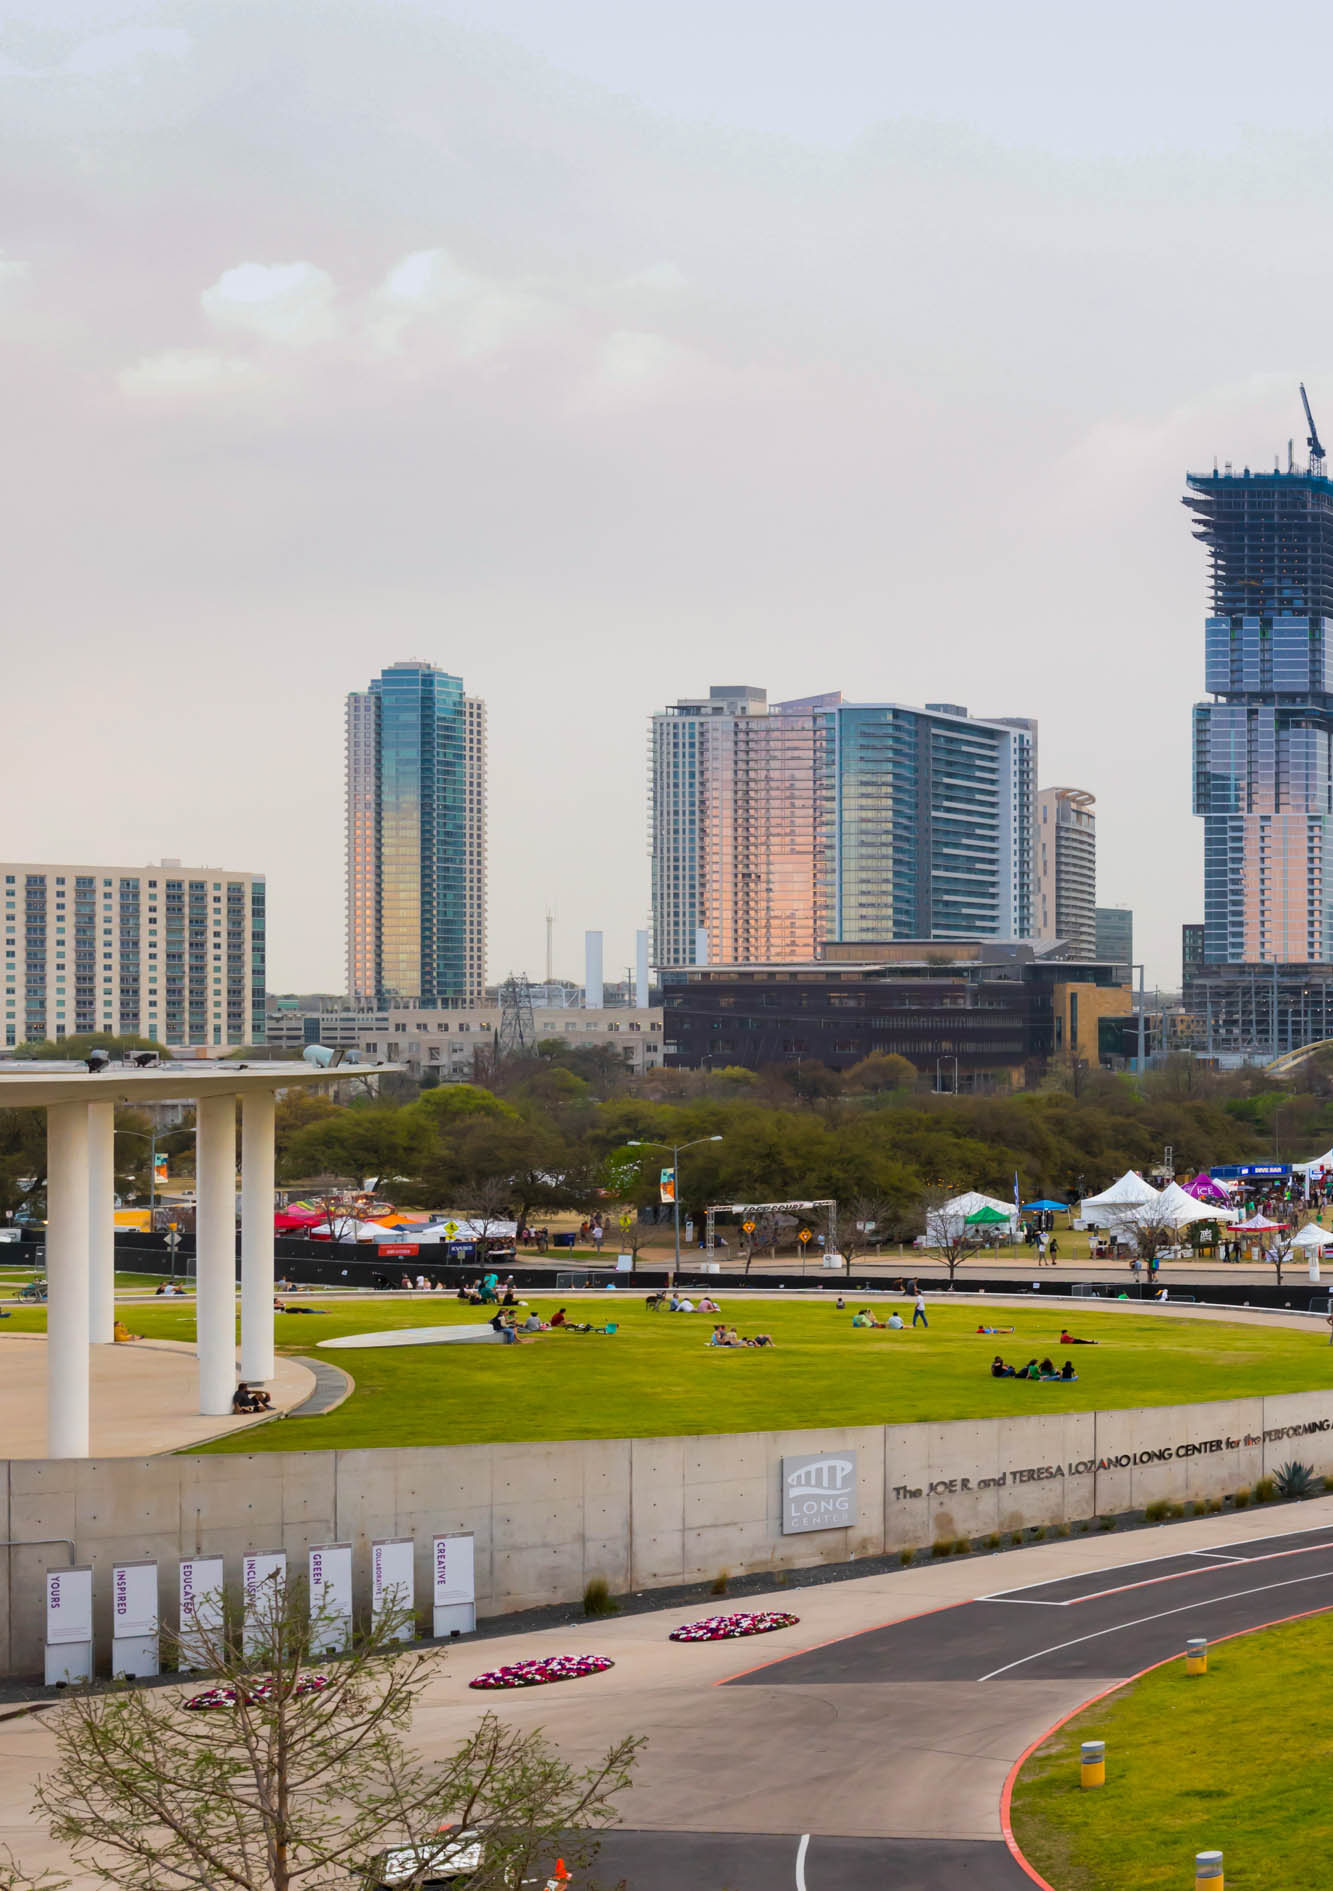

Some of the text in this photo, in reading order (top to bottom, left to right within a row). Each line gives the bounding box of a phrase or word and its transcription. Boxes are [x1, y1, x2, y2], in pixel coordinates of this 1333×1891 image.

[1197, 1187, 1214, 1195] ICE
[893, 1486, 923, 1500] The
[926, 1478, 957, 1496] JOE
[977, 1472, 1006, 1490] and
[1010, 1464, 1064, 1484] TERESA
[1068, 1455, 1131, 1476] LOZANO
[1133, 1447, 1173, 1465] LONG
[1175, 1439, 1223, 1458] CENTER
[1225, 1438, 1241, 1450] for
[1243, 1434, 1261, 1447] the
[1262, 1421, 1330, 1444] PERFORMING
[791, 1497, 849, 1517] LONG
[791, 1513, 848, 1527] CENTER
[246, 1559, 256, 1606] INCLUSIV
[312, 1553, 322, 1585] GREEN
[436, 1542, 446, 1585] CREATIVE
[50, 1576, 60, 1609] YOURS
[116, 1570, 127, 1615] INSPIRED
[183, 1564, 193, 1615] EDUCATED
